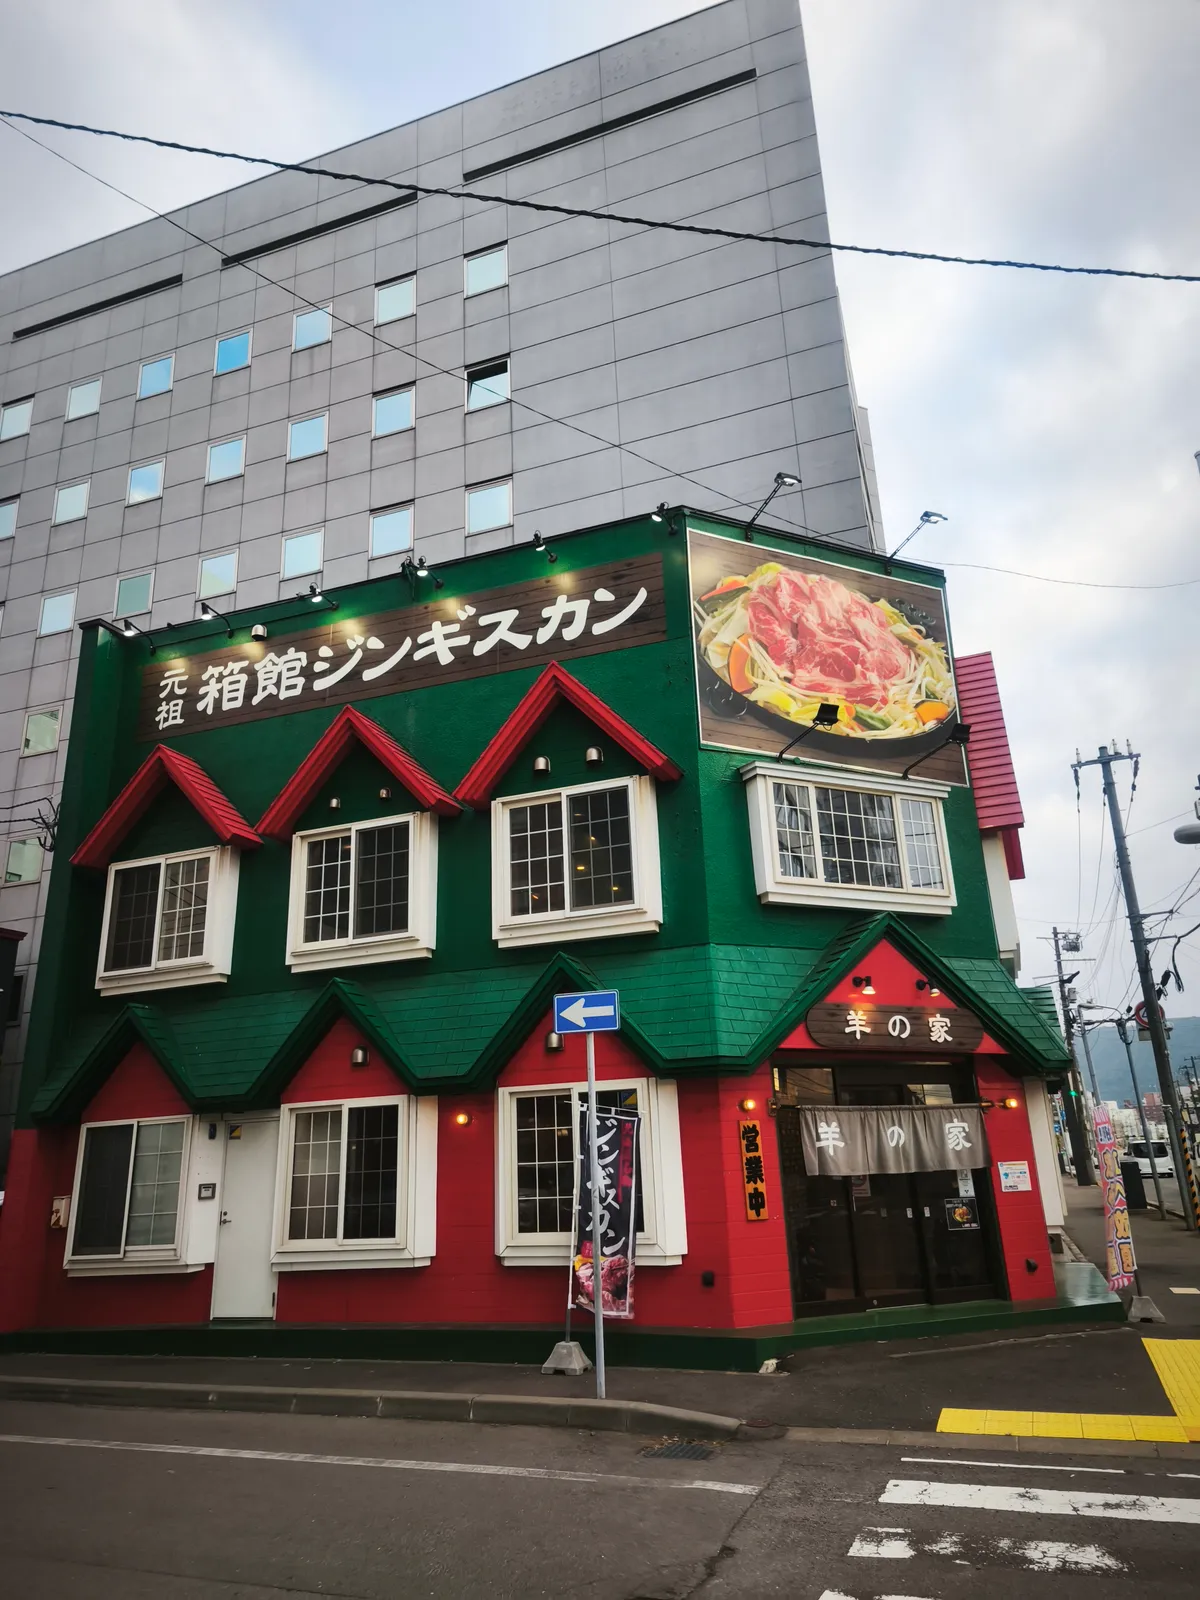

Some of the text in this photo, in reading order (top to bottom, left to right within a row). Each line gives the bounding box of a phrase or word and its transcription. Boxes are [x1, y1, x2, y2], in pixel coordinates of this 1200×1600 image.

[197, 587, 648, 715] 箱館ジンギスカン
[155, 669, 187, 730] 元祖
[845, 1010, 953, 1043] 羊の家
[815, 1118, 972, 1156] 羊の家
[741, 1124, 766, 1217] 営業中
